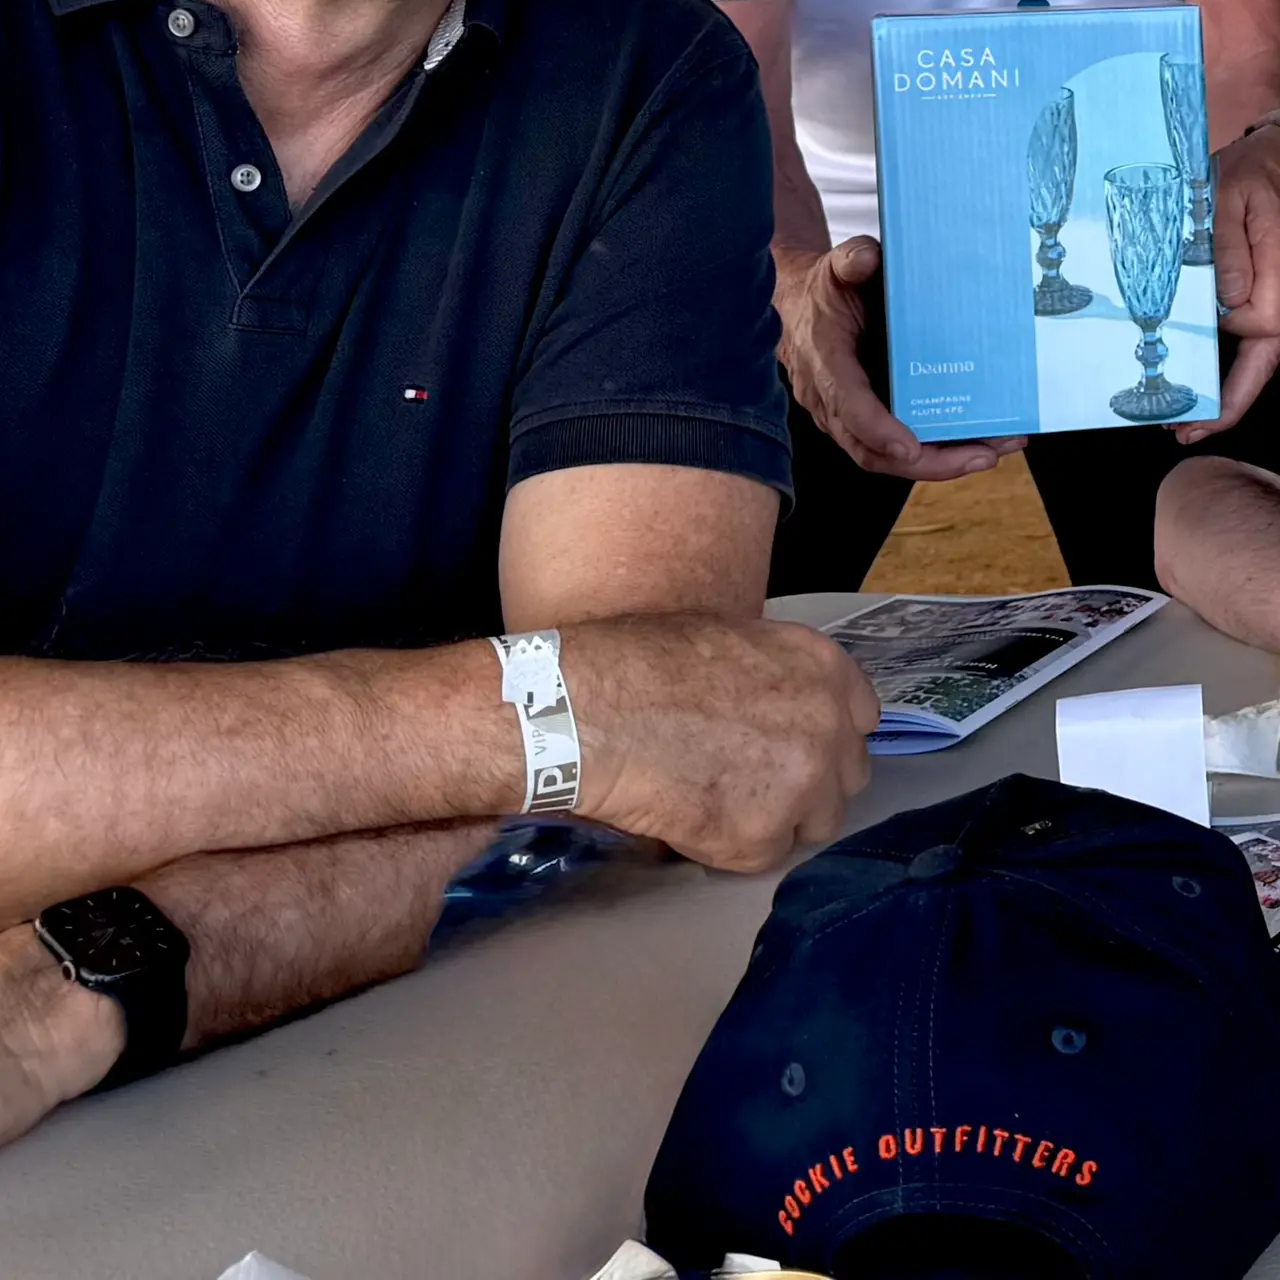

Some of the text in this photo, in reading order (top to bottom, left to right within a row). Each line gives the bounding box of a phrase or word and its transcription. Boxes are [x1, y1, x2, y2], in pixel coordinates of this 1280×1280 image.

[917, 47, 996, 68] CASA
[894, 67, 1020, 92] DOMANI
[534, 728, 547, 757] VIP
[877, 1125, 1099, 1186] OUTFITTERS
